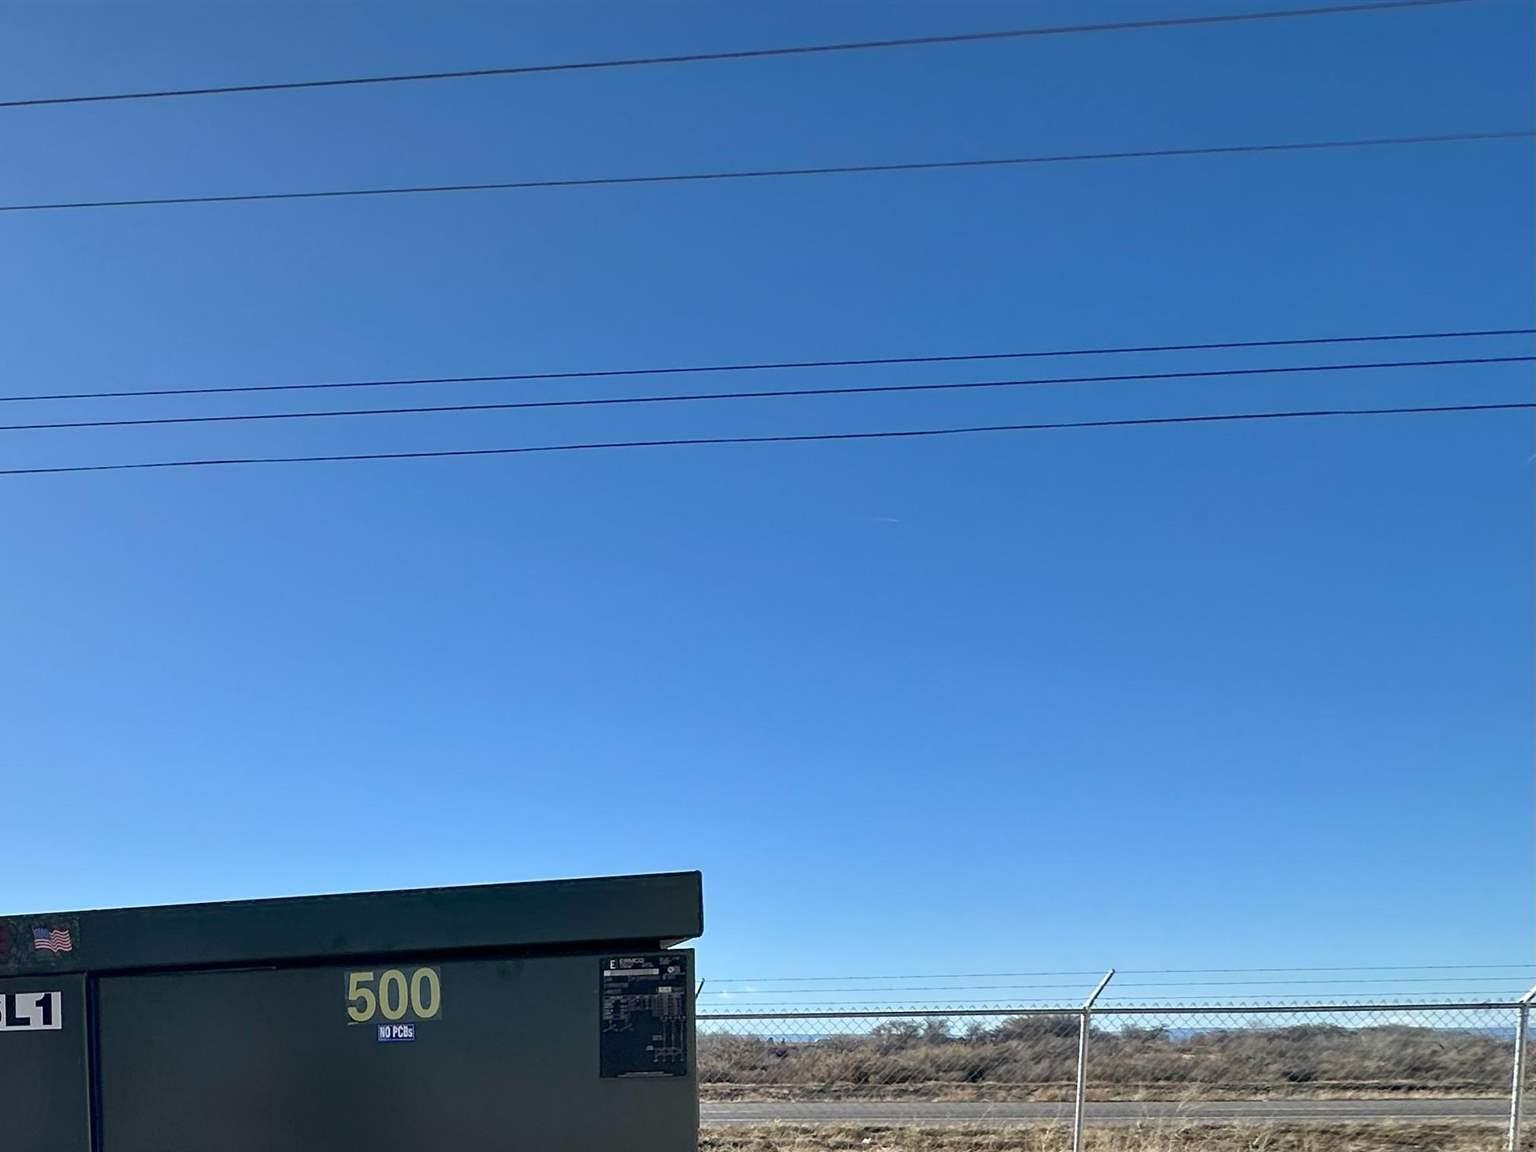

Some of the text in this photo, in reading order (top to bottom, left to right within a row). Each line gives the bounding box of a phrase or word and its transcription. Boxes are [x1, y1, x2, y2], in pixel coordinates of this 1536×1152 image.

[347, 967, 441, 1022] 500
[379, 1025, 413, 1038] NO PCBs
